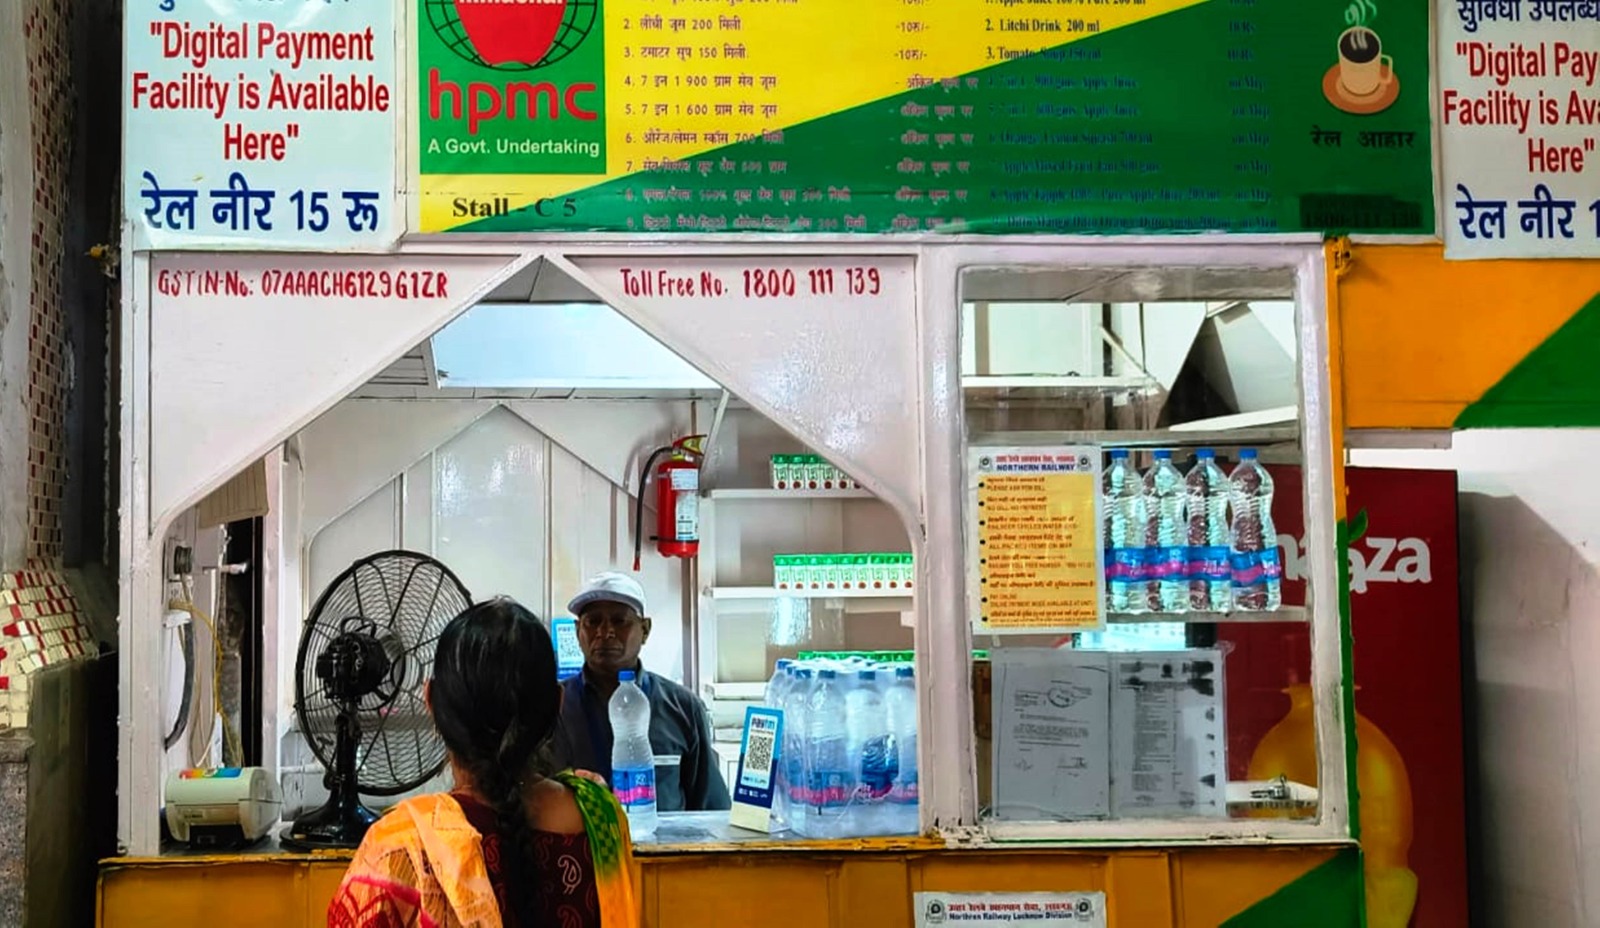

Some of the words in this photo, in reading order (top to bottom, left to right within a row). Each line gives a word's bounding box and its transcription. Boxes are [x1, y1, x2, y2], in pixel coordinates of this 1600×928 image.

[692, 18, 713, 30] 200
[1000, 19, 1029, 32] Litchi
[1032, 19, 1061, 32] Drink
[1067, 19, 1084, 32] 200
[1087, 19, 1100, 32] ml
[150, 22, 248, 67] "Digital
[257, 22, 374, 69] Payment
[699, 47, 718, 58] 150
[997, 47, 1036, 60] Tomato
[1456, 42, 1546, 86] "Digital
[132, 72, 229, 118] Facility
[238, 72, 260, 110] is
[267, 72, 390, 112] Available
[641, 76, 647, 87] 7
[675, 76, 680, 87] 1
[686, 76, 707, 87] 900
[428, 68, 599, 134] hpmc
[642, 104, 648, 115] 7
[675, 104, 680, 115] 1
[687, 104, 708, 115] 600
[1443, 90, 1530, 133] Facility
[1539, 90, 1559, 125] is
[223, 123, 299, 161] Here"
[428, 140, 441, 154] A
[445, 139, 491, 155] Govt.
[496, 139, 600, 158] Undertaking
[1528, 138, 1594, 173] Here"
[141, 171, 197, 230] रेल
[211, 172, 275, 231] नीर
[290, 192, 329, 231] 15
[452, 198, 510, 219] Stall
[535, 198, 556, 218] C
[564, 198, 578, 218] 5
[1456, 183, 1507, 239] रेल
[1518, 183, 1576, 239] नीर
[620, 268, 653, 297] Toll
[658, 270, 695, 296] Free
[701, 271, 728, 298] No.
[743, 268, 796, 298] 1800
[808, 268, 833, 294] 111
[846, 267, 881, 295] 139
[983, 912, 1011, 922] Railway
